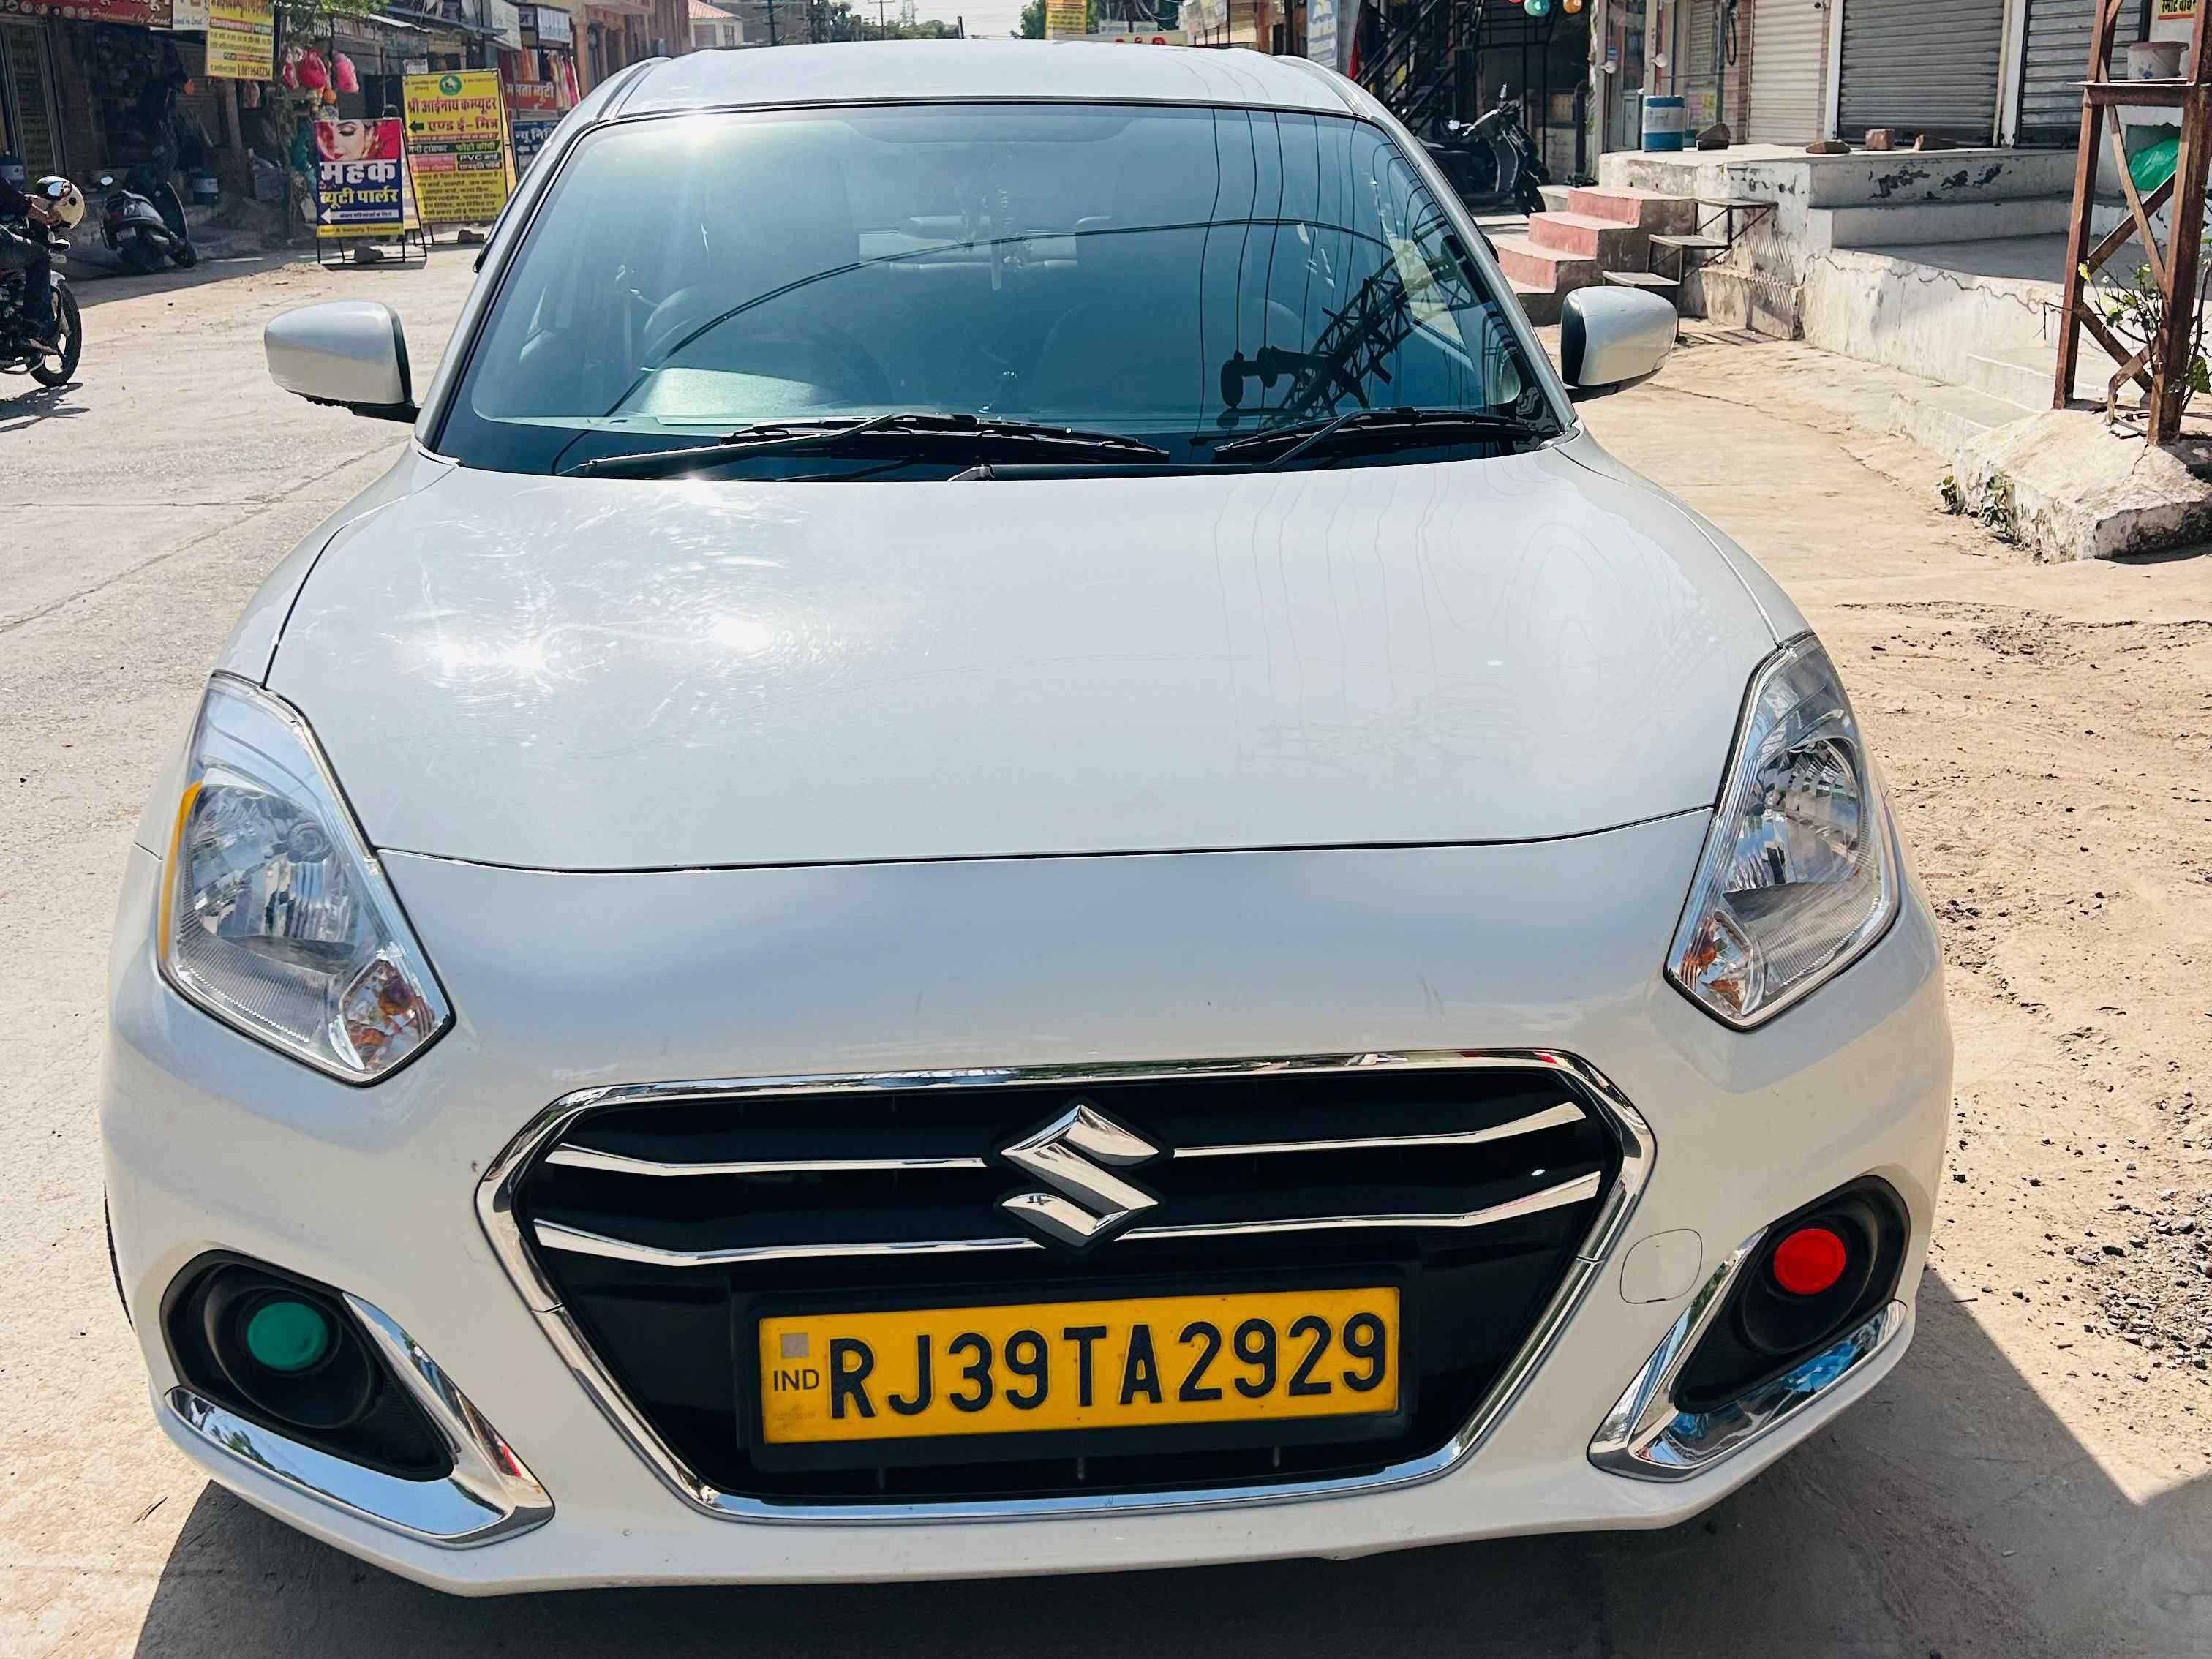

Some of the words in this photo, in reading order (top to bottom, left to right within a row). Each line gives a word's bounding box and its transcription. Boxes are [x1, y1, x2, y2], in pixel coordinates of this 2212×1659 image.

[319, 159, 398, 184] महक
[319, 187, 355, 209] ब्यूटी
[356, 185, 399, 203] पार्लर
[773, 1369, 820, 1391] IND
[830, 1312, 1386, 1419] RJ39TA2929
